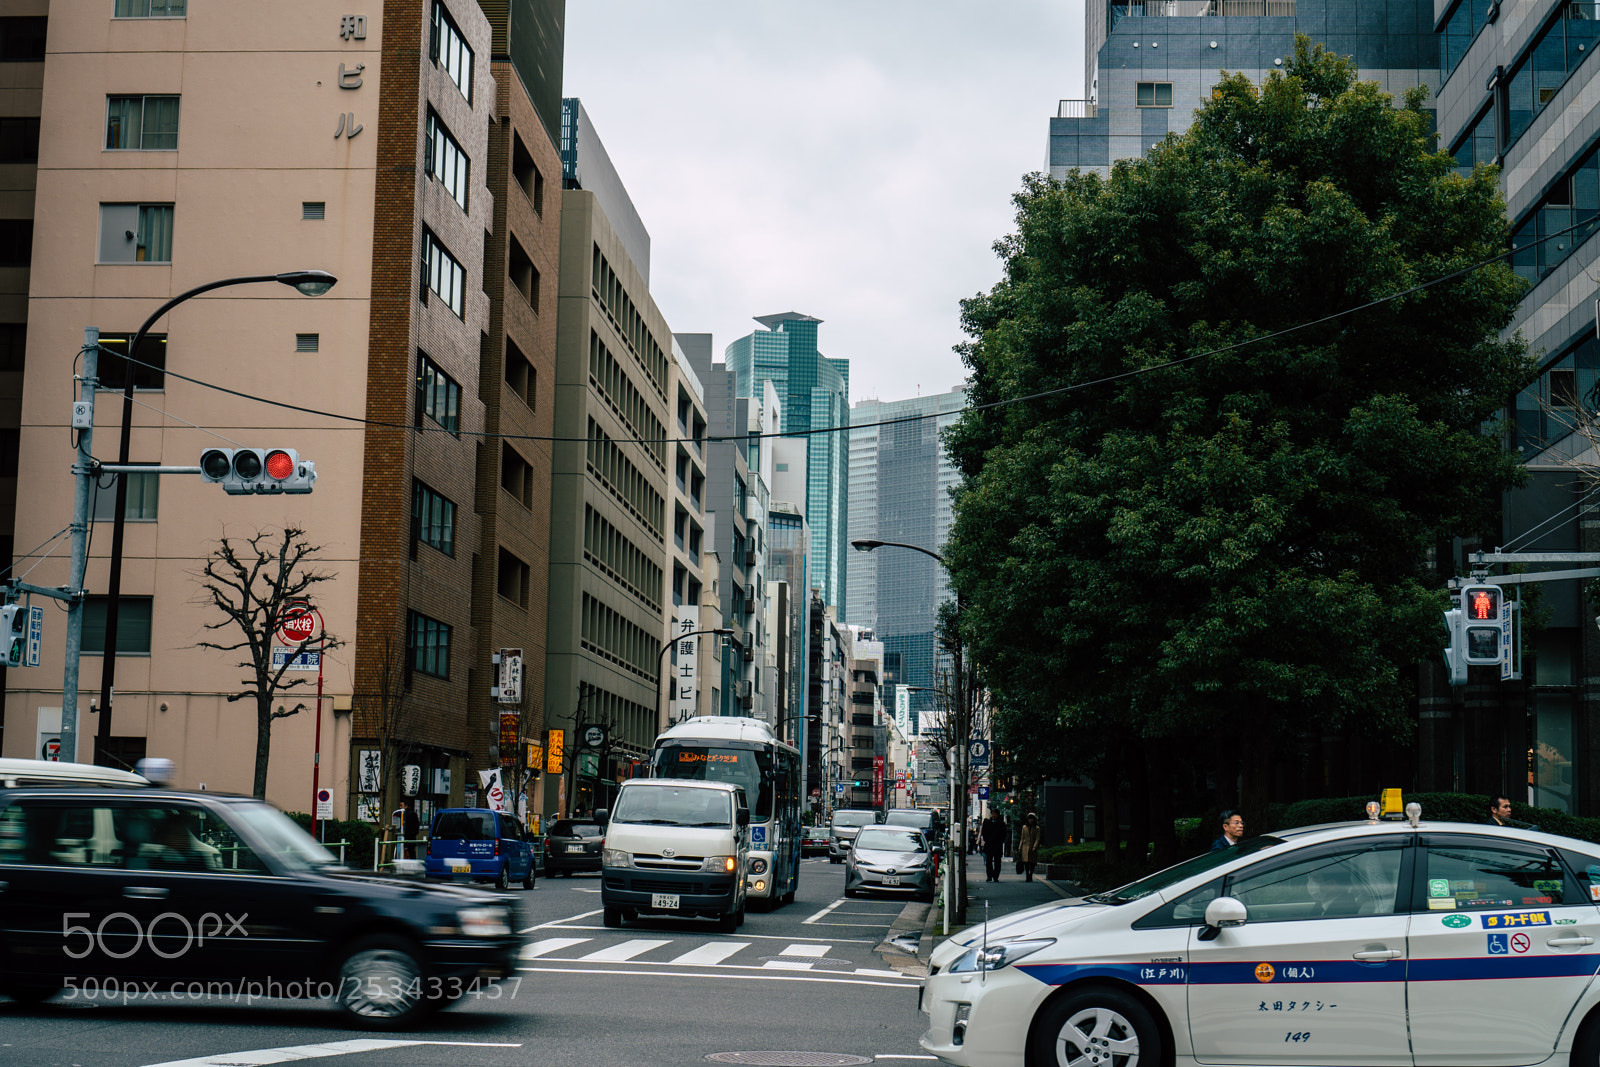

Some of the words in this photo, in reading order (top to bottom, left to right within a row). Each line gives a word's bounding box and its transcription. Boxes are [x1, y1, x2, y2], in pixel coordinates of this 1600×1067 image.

[335, 14, 367, 140] 和ビル
[284, 617, 313, 632] 消火栓
[679, 618, 695, 722] 弁護士ビル
[1140, 968, 1185, 980] (江戸川)
[1282, 967, 1315, 979] (個人)
[1258, 1001, 1338, 1012] 太田タクシー
[1284, 1031, 1311, 1043] 149
